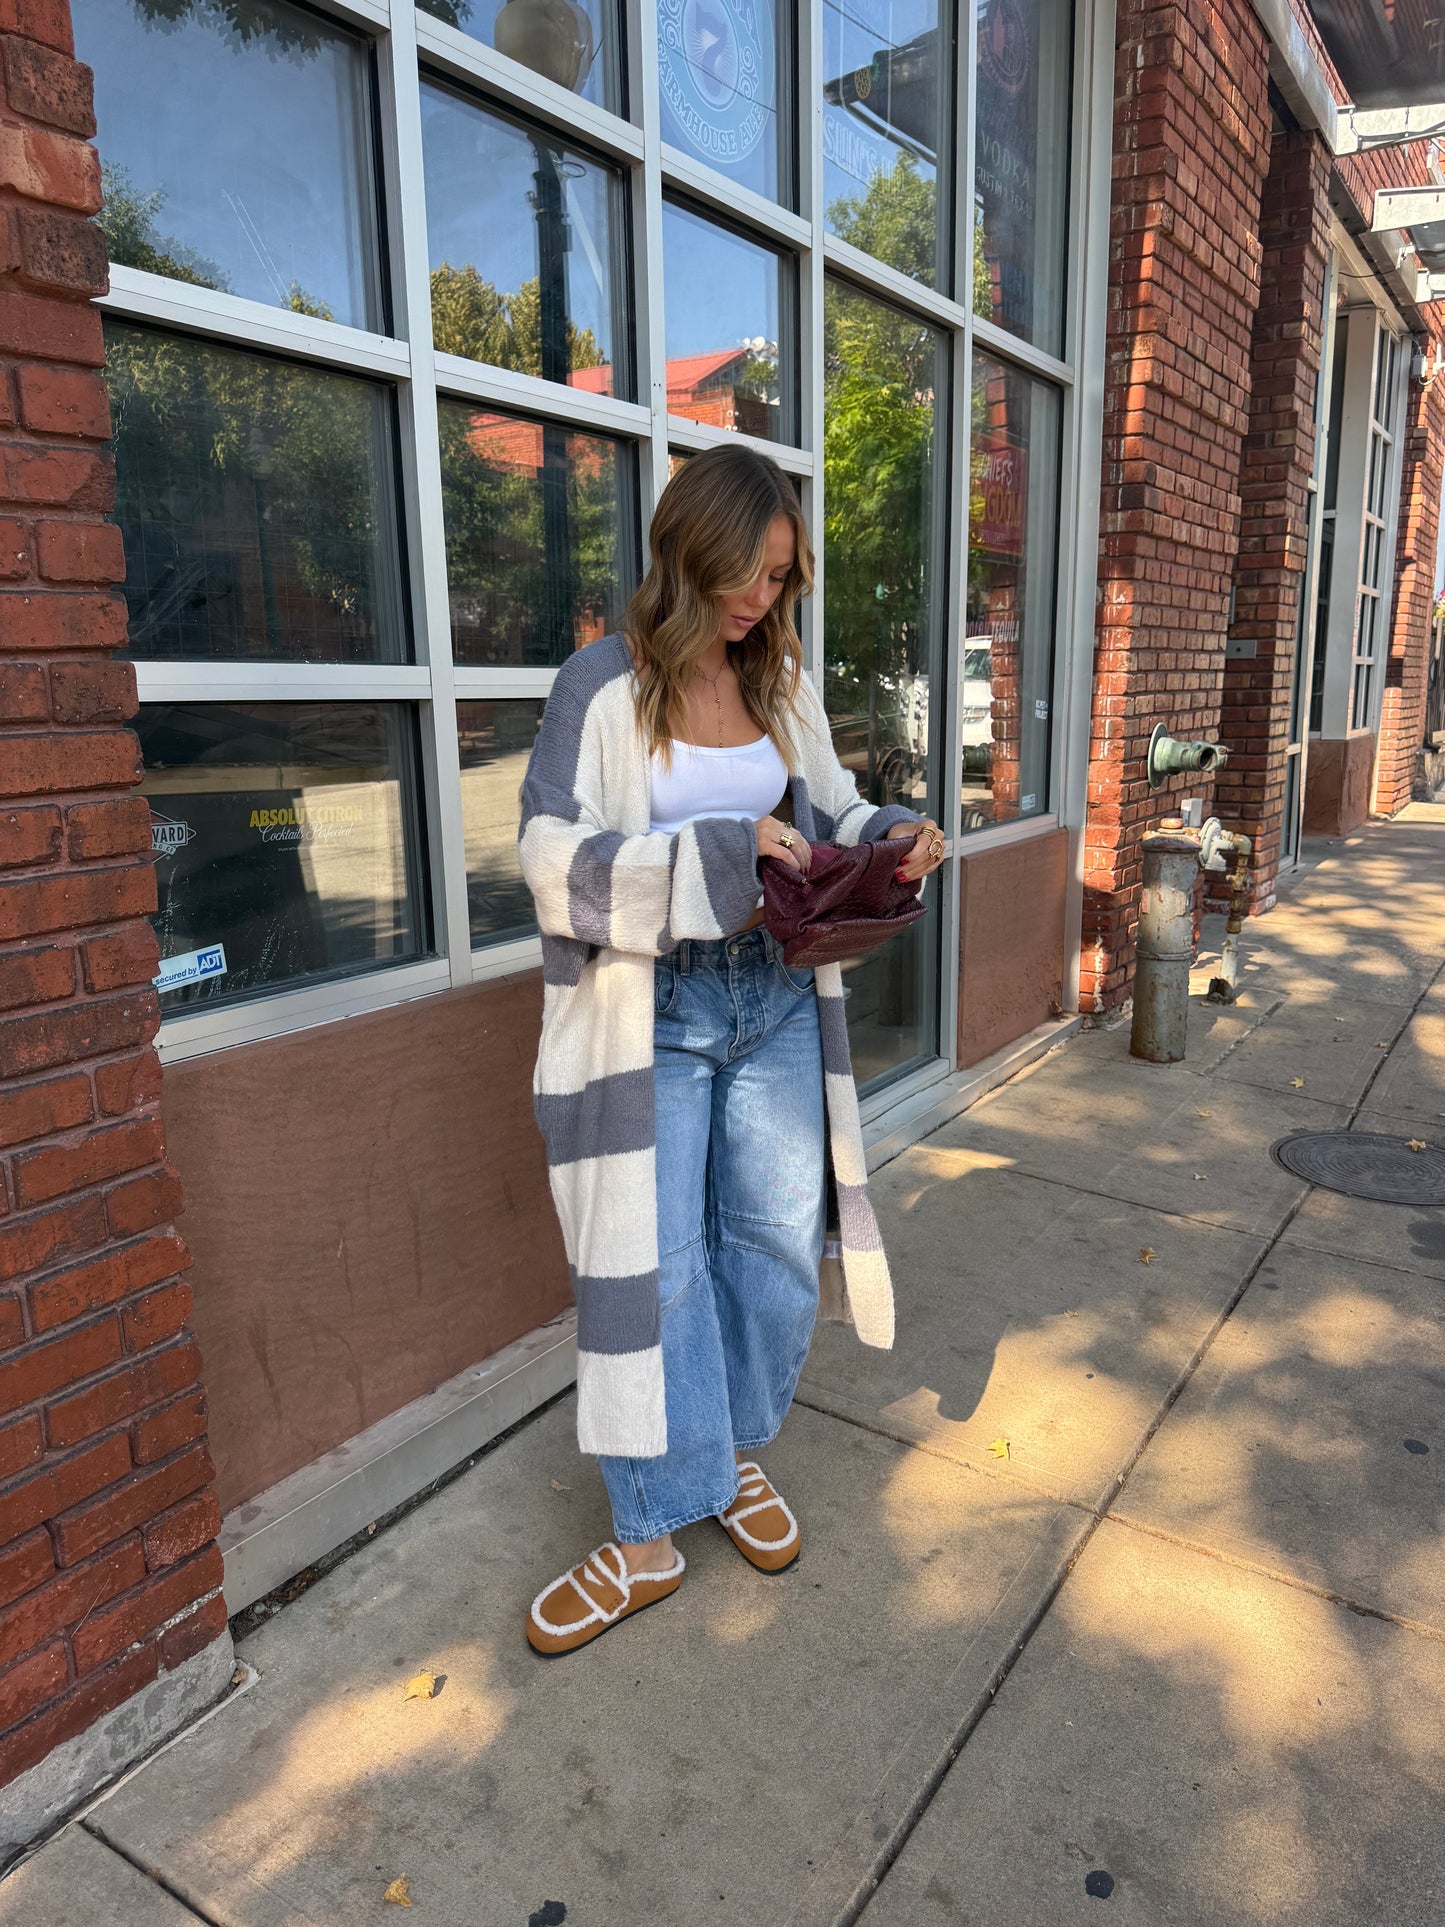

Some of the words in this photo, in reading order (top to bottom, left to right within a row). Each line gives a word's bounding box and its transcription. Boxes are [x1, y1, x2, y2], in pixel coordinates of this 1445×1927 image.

[739, 103, 765, 149] ALE
[981, 128, 1031, 193] VODKA
[249, 806, 314, 828] ABSOLUT
[316, 805, 363, 823] CITRON
[258, 823, 304, 843] Cocktails
[305, 820, 354, 843] Perfected
[155, 967, 187, 985] secured
[187, 967, 198, 976] by
[199, 952, 222, 971] ADT
